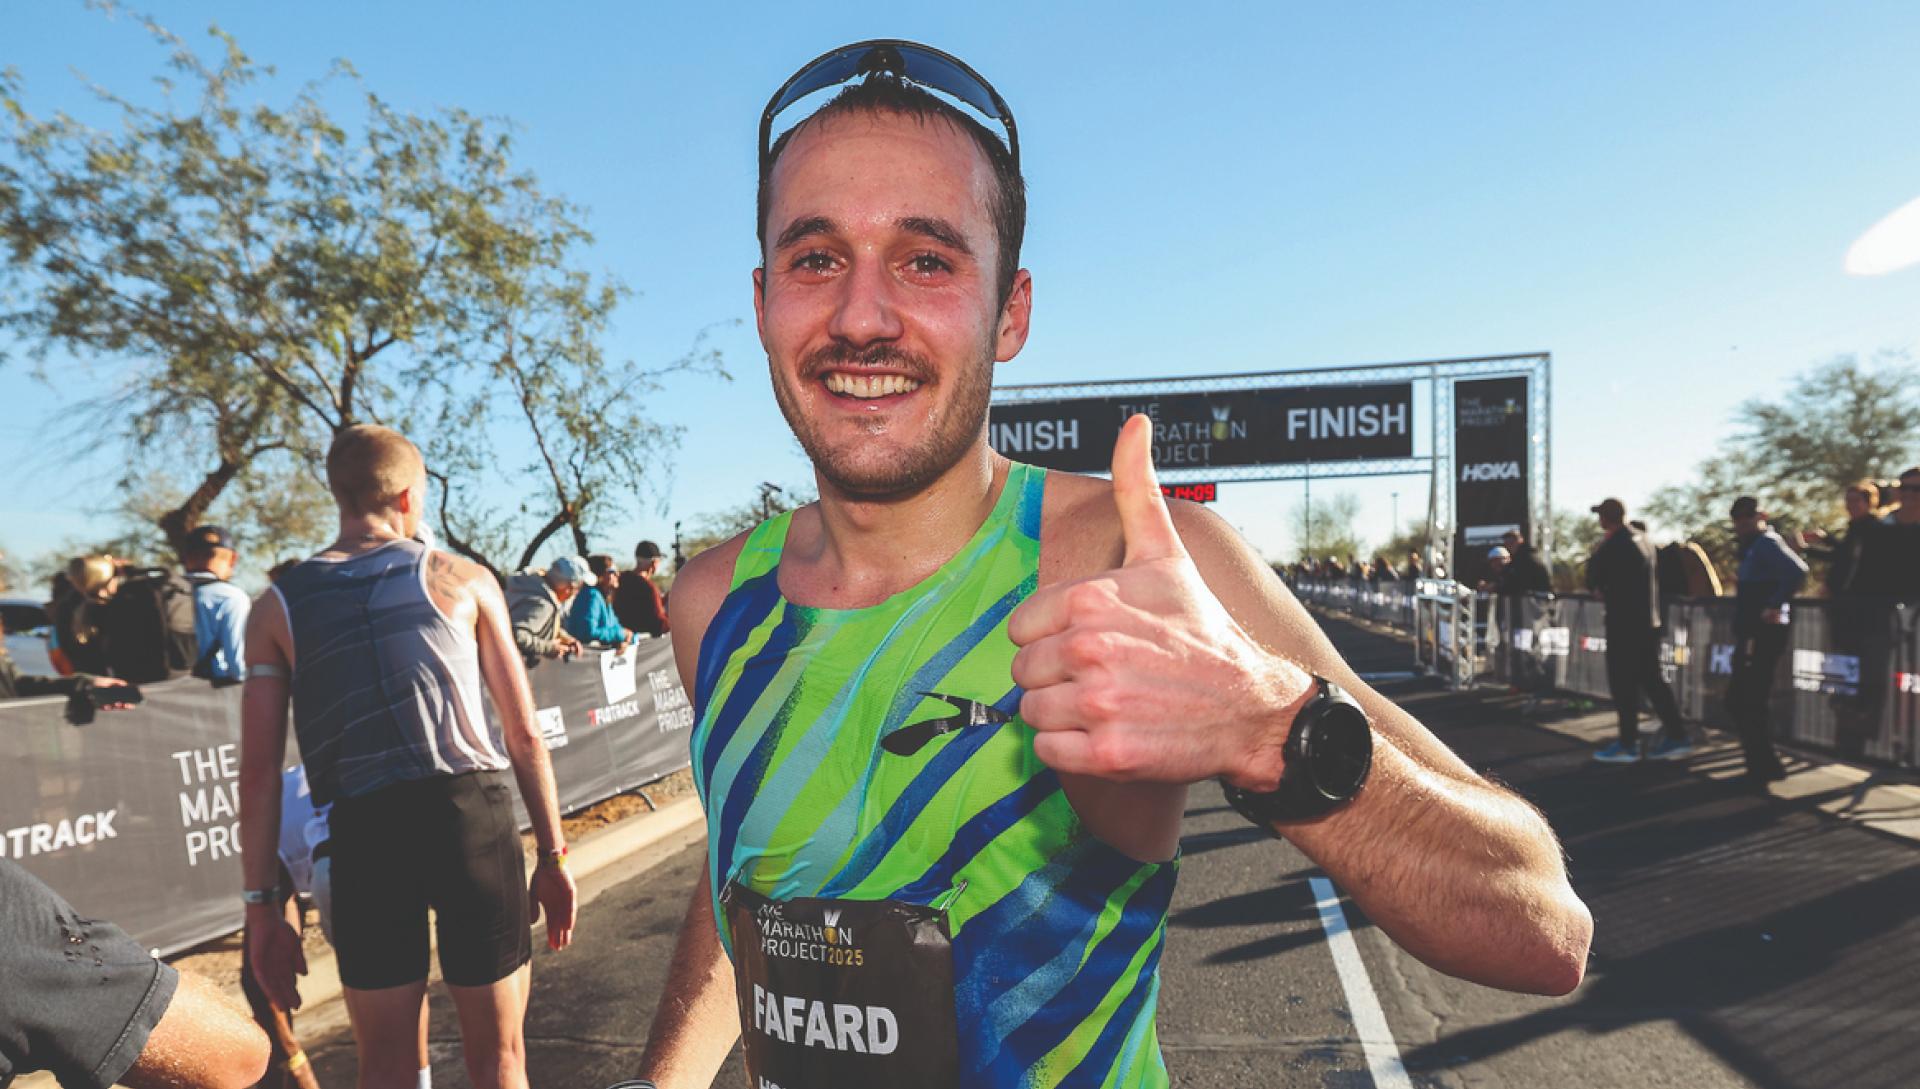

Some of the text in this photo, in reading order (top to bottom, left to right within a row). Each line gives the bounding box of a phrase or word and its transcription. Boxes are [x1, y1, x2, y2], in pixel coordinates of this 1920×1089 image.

[1119, 403, 1161, 422] THE
[1287, 402, 1406, 441] FINISH
[990, 418, 1079, 452] INISH
[1118, 419, 1248, 443] RATHON
[1151, 442, 1213, 464] OJECT
[1461, 461, 1521, 482] HOKA
[172, 743, 240, 785] THE
[0, 809, 117, 860] TRACK
[757, 917, 853, 946] MARATHON
[753, 983, 899, 1055] FAFARD
